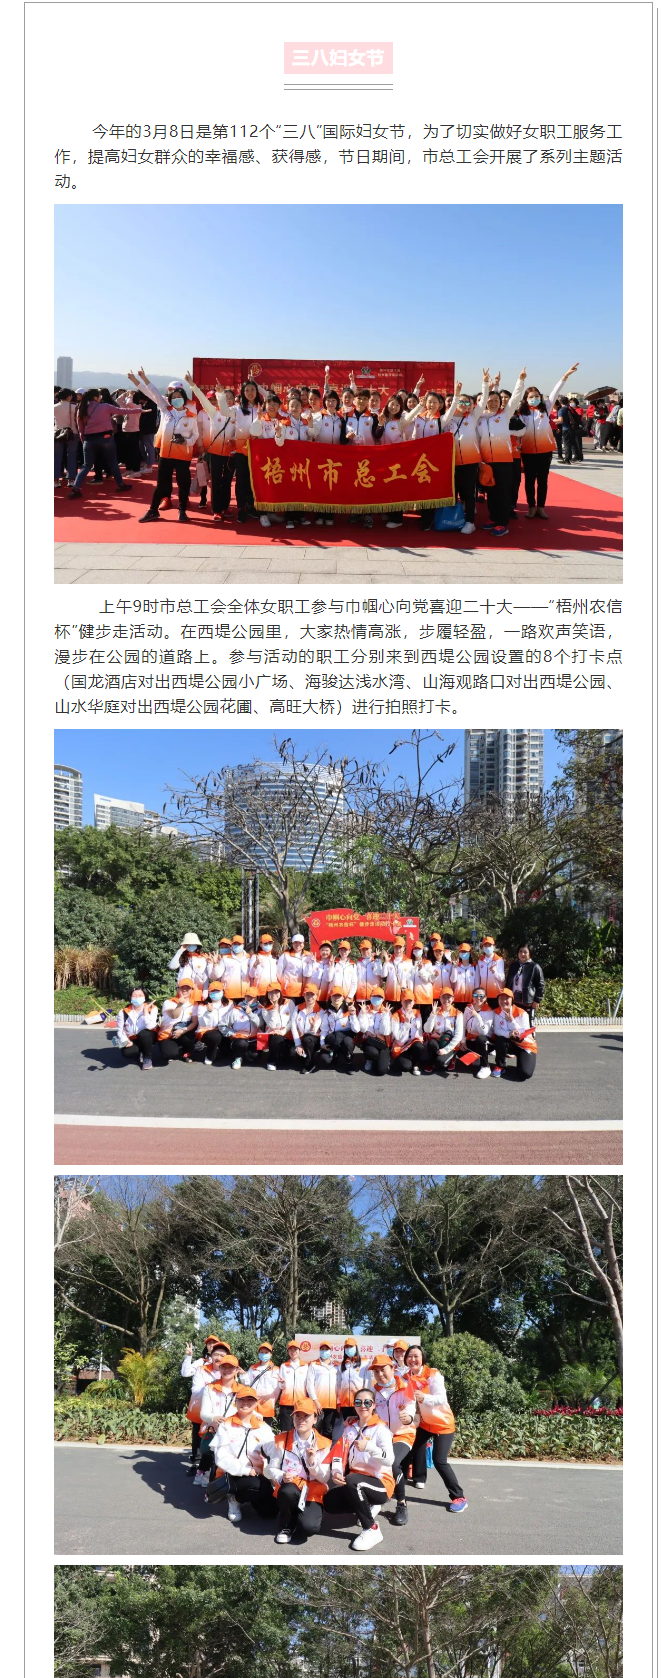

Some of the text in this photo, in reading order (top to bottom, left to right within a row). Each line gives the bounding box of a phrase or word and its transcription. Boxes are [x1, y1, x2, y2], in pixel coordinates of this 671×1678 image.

[291, 49, 385, 67] 三八妇女节
[54, 148, 623, 164] 作，提高妇女群众的幸福感、获得感，节日期间，市总工会开展了系列主题活
[54, 174, 77, 190] 动。
[260, 452, 440, 491] 梧州市总工会
[54, 649, 623, 665] 漫步在公园的道路上。参与活动的职工分别来到西堤公园设置的8个打卡点
[55, 698, 458, 715] 山水华庭对出西堤公园花圃、高旺大桥）进行拍照打卡。
